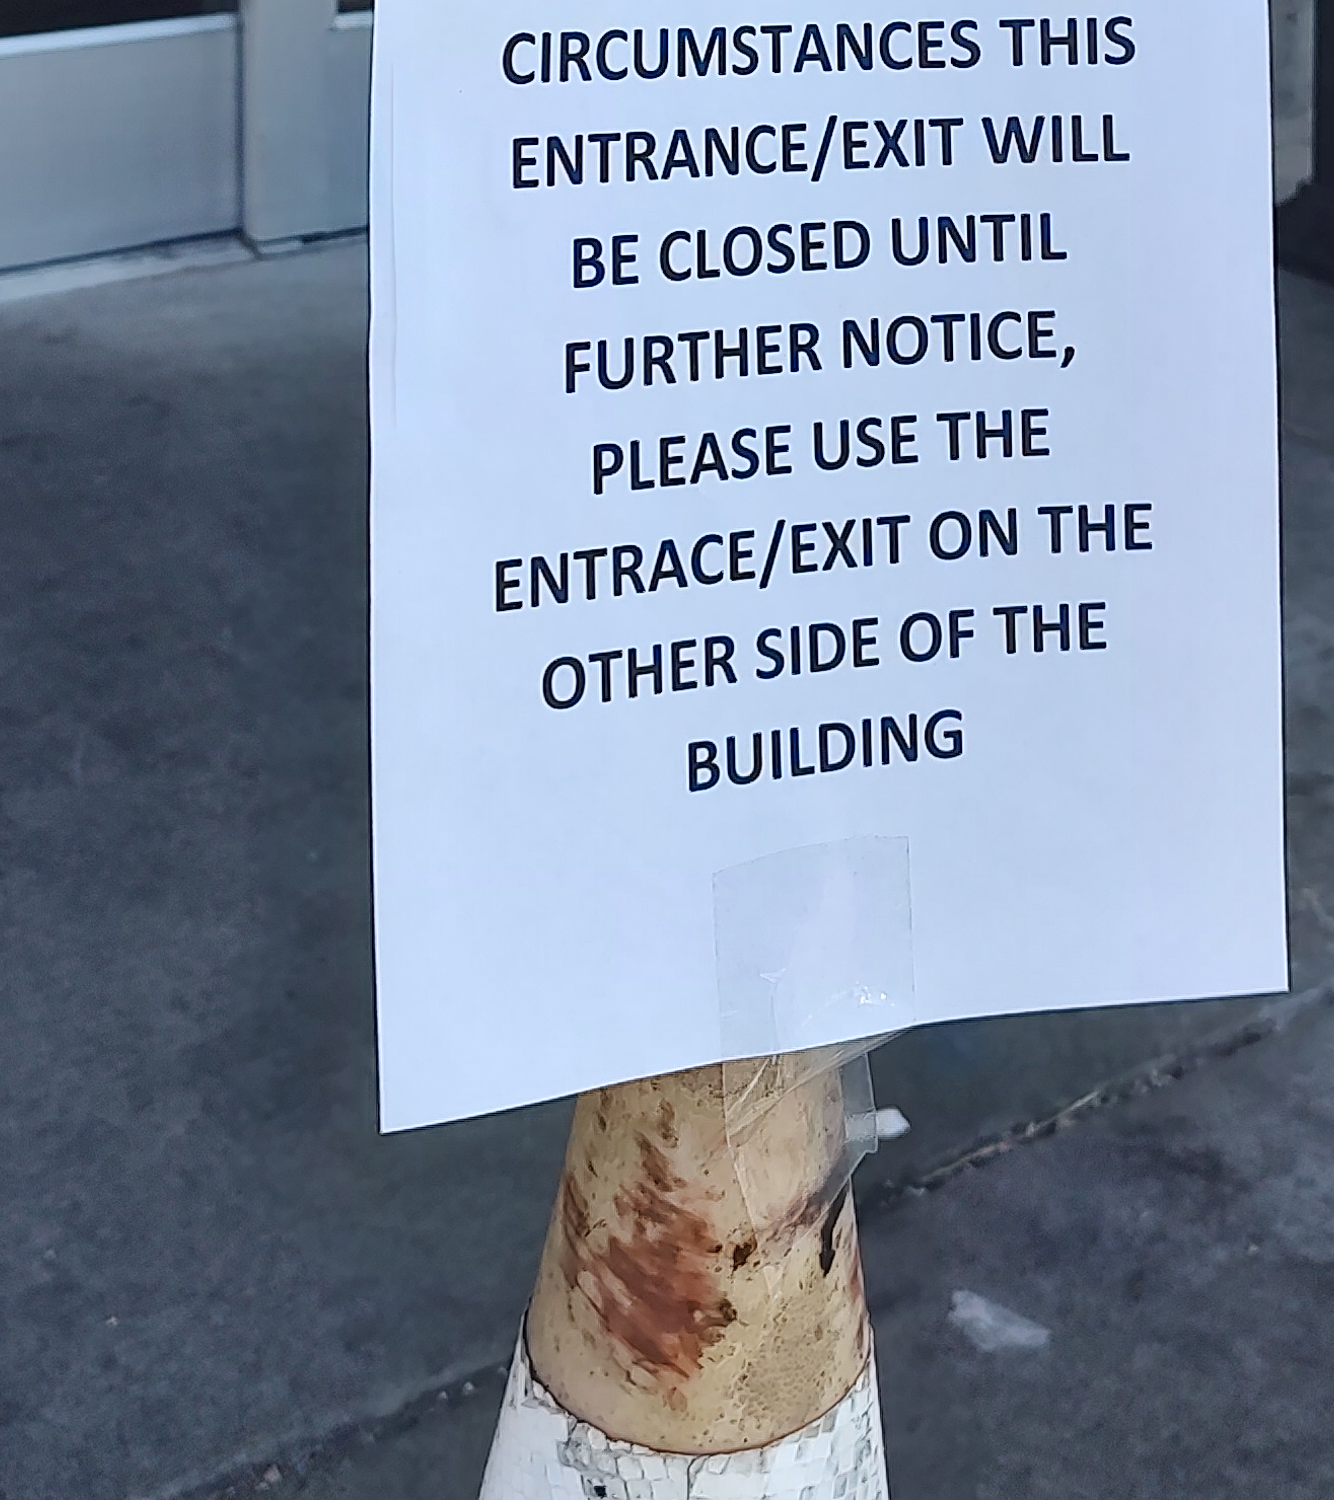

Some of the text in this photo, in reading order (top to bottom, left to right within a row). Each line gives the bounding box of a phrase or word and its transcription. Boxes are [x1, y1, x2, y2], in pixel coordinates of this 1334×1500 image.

[501, 14, 1137, 86] CIRCUMSTANCES THIS
[511, 113, 1132, 190] ENTRANCE/EXIT WILL
[572, 211, 1069, 290] BE CLOSED UNTIL
[564, 309, 1077, 395] FURTHER NOTICE,
[592, 407, 1051, 497] PLEASE USE THE
[494, 502, 1154, 614] ENTRACE/EXIT ON THE
[541, 600, 1108, 711] OTHER SIDE OF THE
[687, 708, 964, 794] BUILDING
